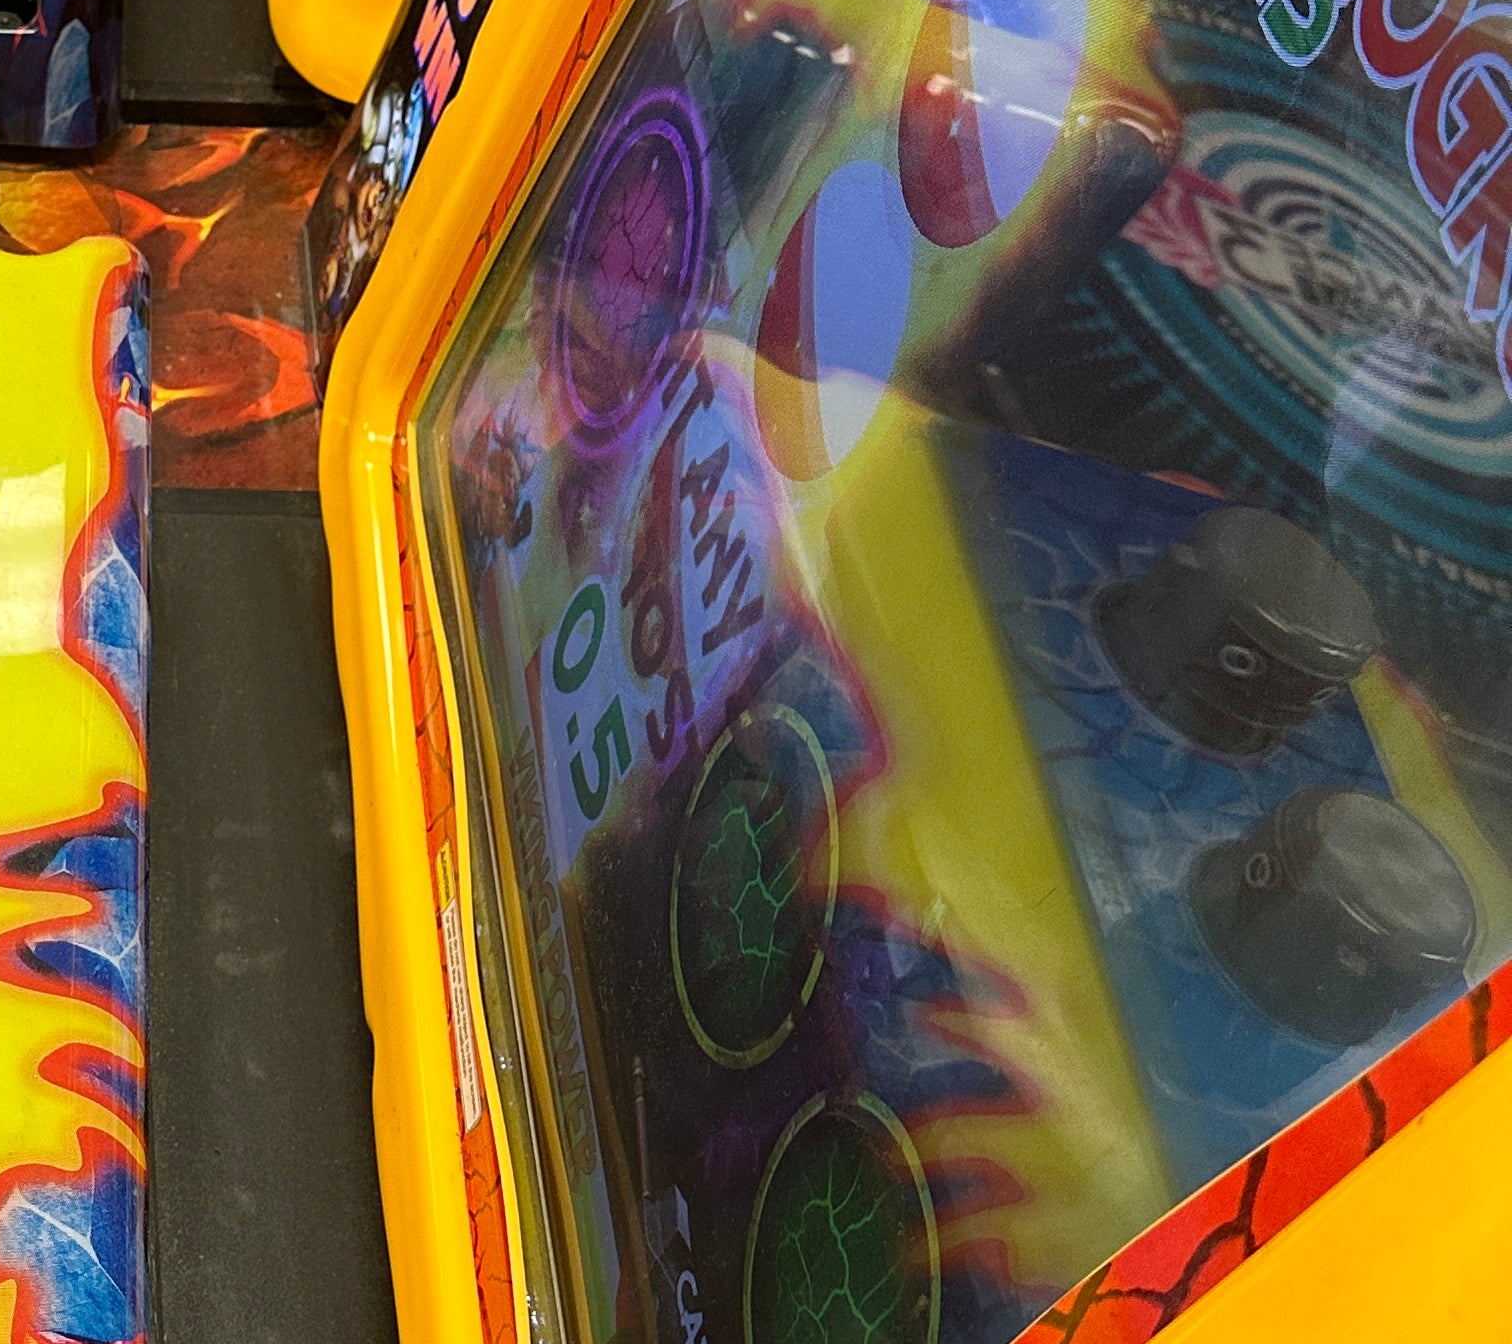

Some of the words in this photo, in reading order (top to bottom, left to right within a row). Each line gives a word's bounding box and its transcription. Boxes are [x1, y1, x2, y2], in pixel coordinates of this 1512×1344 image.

[679, 441, 766, 657] ANY
[552, 582, 634, 823] 0.5
[509, 723, 558, 938] VIKING
[538, 927, 595, 1182] POWER
